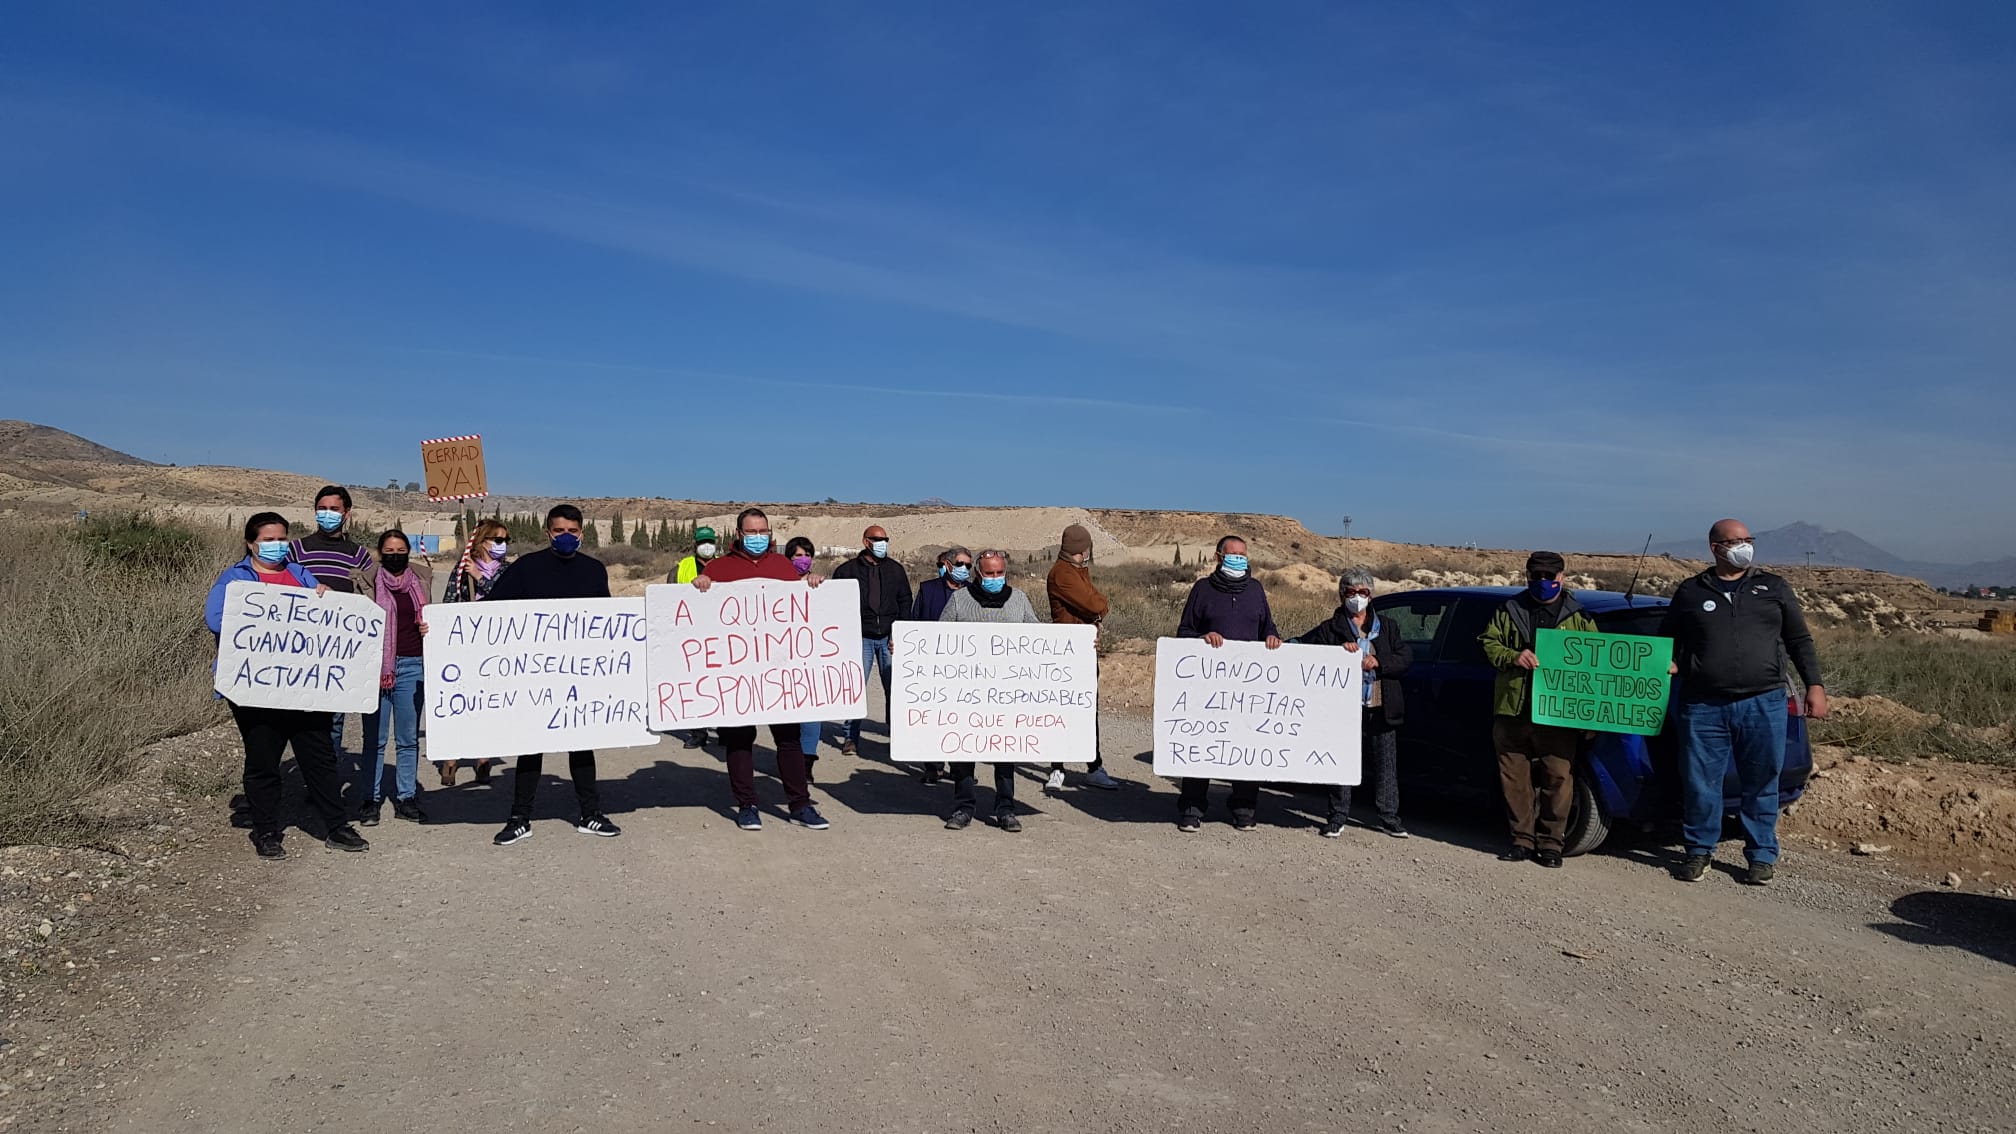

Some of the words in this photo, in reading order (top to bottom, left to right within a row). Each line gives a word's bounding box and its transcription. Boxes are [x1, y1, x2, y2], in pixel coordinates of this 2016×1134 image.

[441, 464, 481, 492] YA!
[675, 600, 693, 626] A
[681, 627, 839, 672] PEDIMOS
[936, 634, 977, 657] LUIS
[991, 635, 1075, 656] BARCALA
[1564, 637, 1652, 671] STOP
[233, 658, 346, 691] ACTUAR
[441, 664, 461, 682] O
[1002, 663, 1073, 682] SANTOS
[1176, 655, 1280, 683] CUANDO
[1301, 663, 1350, 689] VAN
[1543, 668, 1661, 700] VERTIDOS
[528, 688, 553, 706] VA
[567, 685, 578, 702] A
[658, 660, 863, 722] RESPONSABILIDAD
[958, 688, 981, 704] LOS
[988, 688, 1093, 708] RESPONSABLES
[1172, 691, 1186, 712] A
[1205, 691, 1305, 717] LIMPIAR
[908, 709, 931, 726] DE
[938, 709, 959, 725] LO
[968, 712, 1005, 728] QUE
[1015, 714, 1066, 728] PUEDA
[1539, 695, 1662, 728] ILEGALES
[1164, 718, 1229, 736] TODOS
[1256, 718, 1301, 736] LOS
[941, 731, 1040, 754] OCURRIR
[1169, 740, 1291, 768] RESIDUOS
